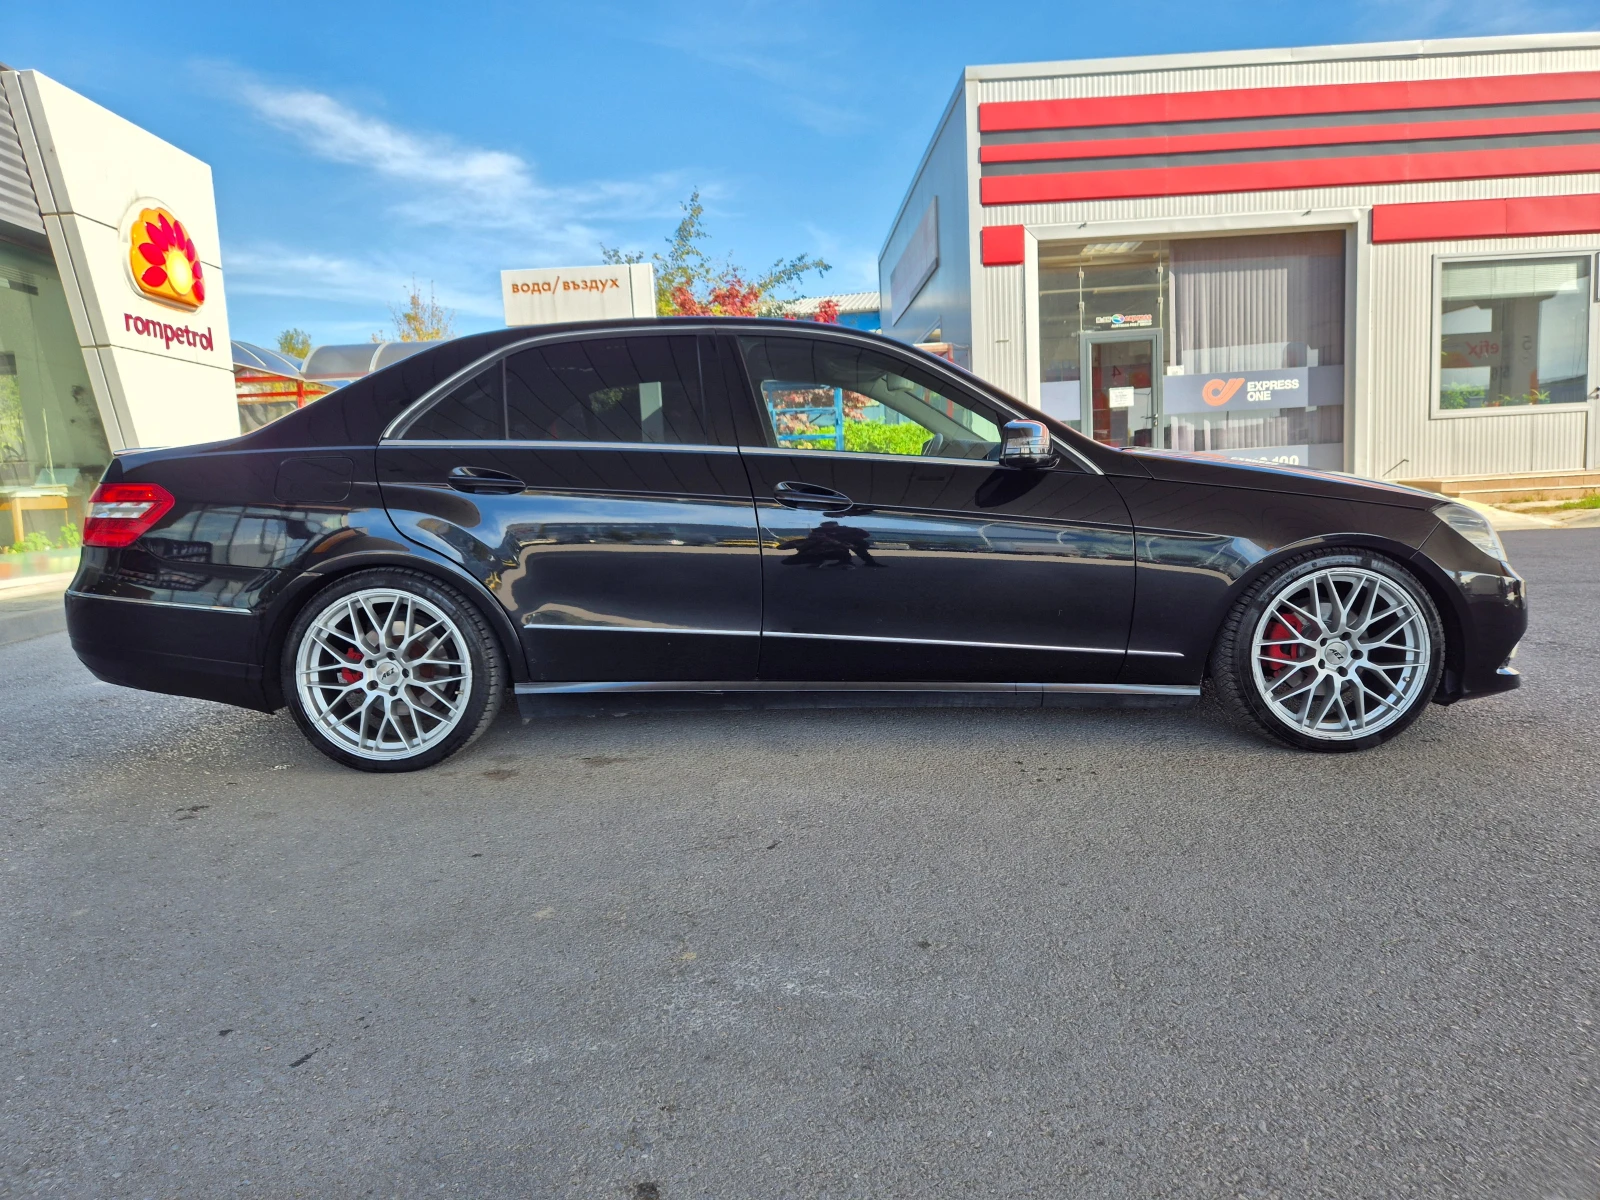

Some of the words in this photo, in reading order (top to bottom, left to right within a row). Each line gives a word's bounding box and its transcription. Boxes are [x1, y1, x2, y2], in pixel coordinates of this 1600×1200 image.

[123, 312, 214, 352] rompetrol
[1247, 379, 1300, 392] EXPRESS
[1247, 391, 1272, 402] ONE
